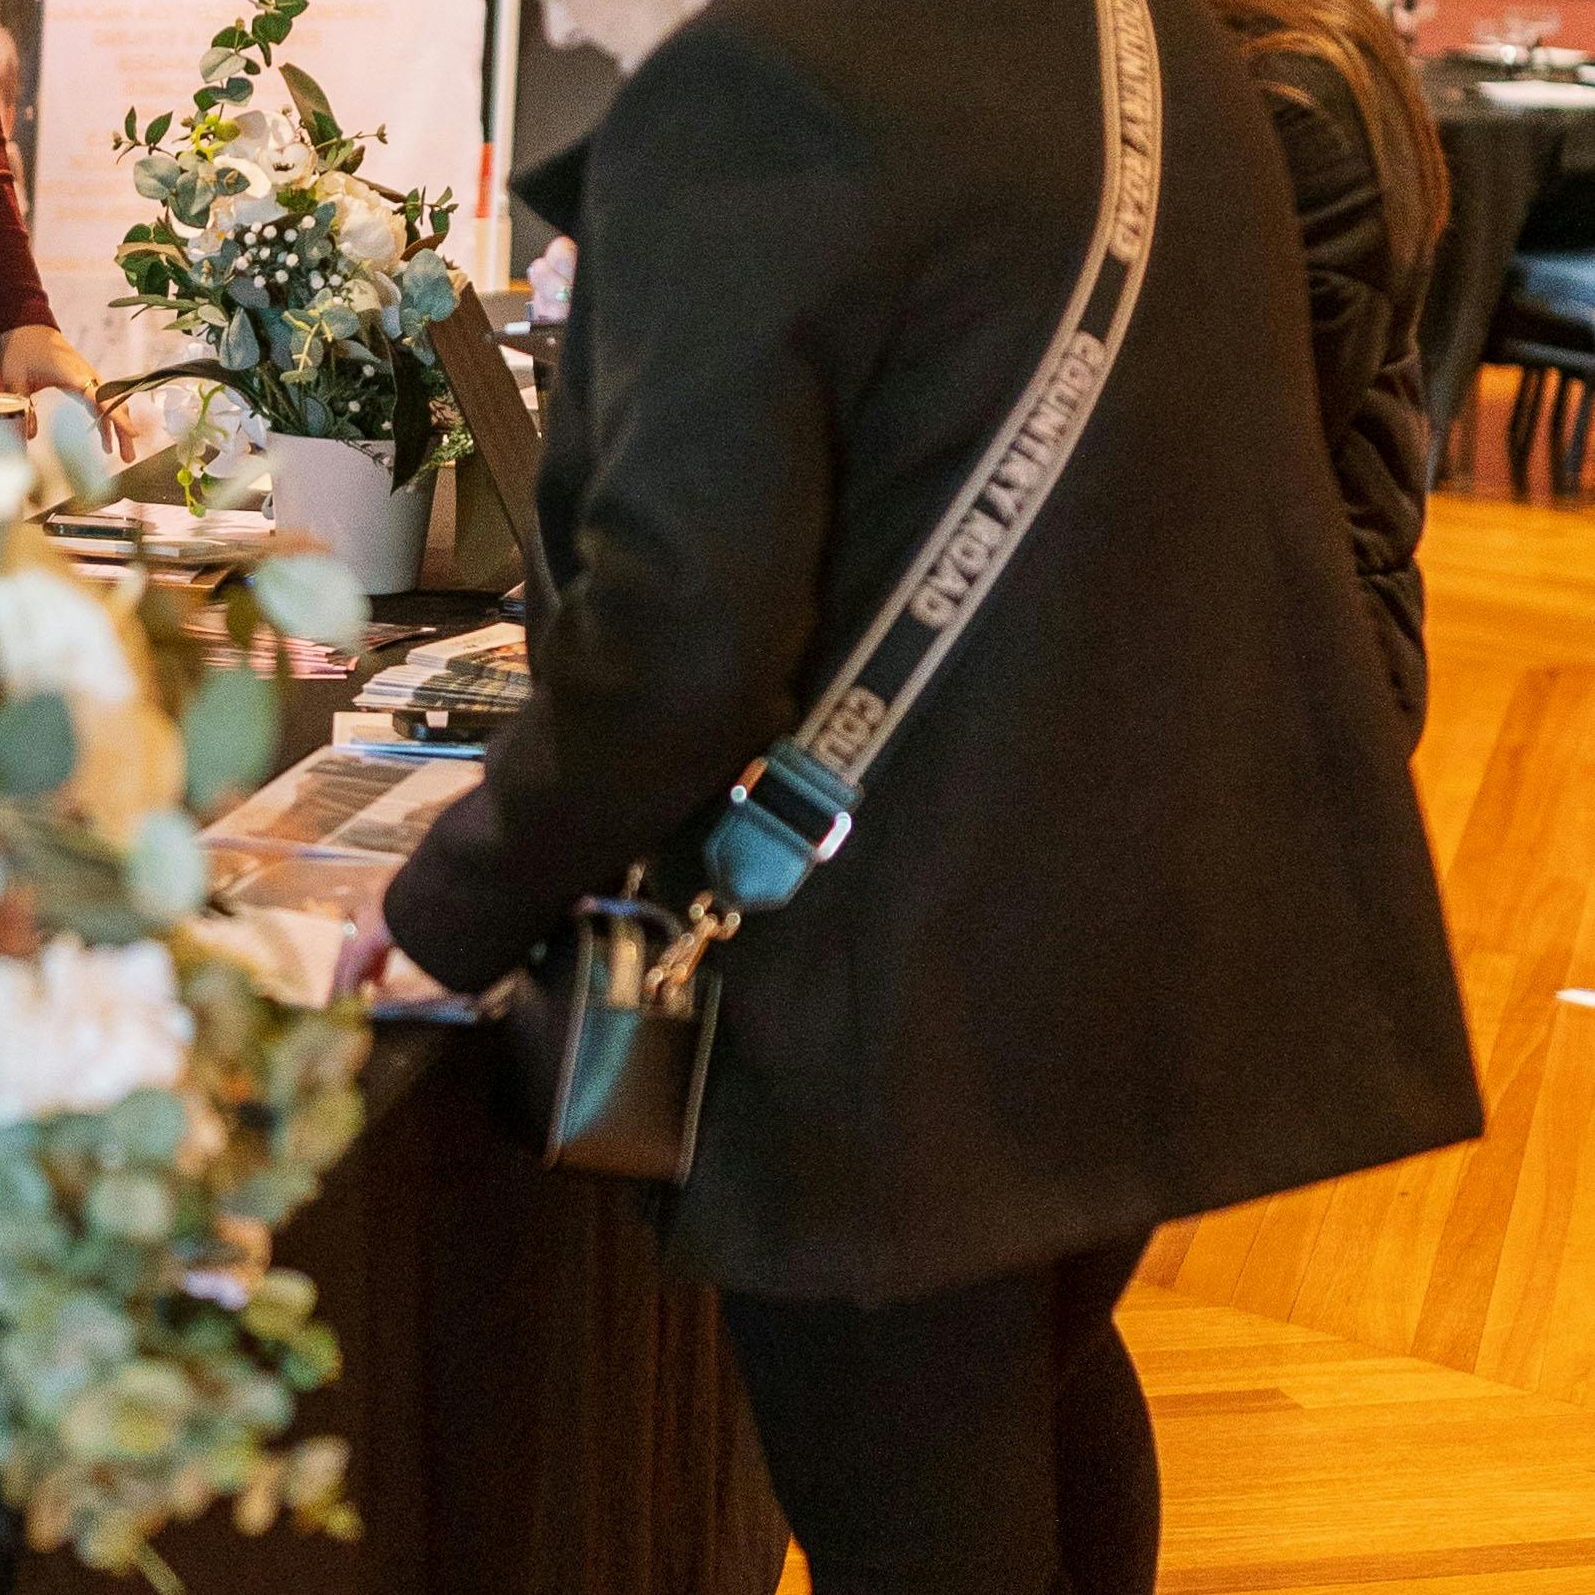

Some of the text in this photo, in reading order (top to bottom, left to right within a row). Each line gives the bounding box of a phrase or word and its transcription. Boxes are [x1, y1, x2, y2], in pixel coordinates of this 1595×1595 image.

[1108, 143, 1152, 263] ROAD
[908, 330, 1106, 630] COUNTRY ROAD
